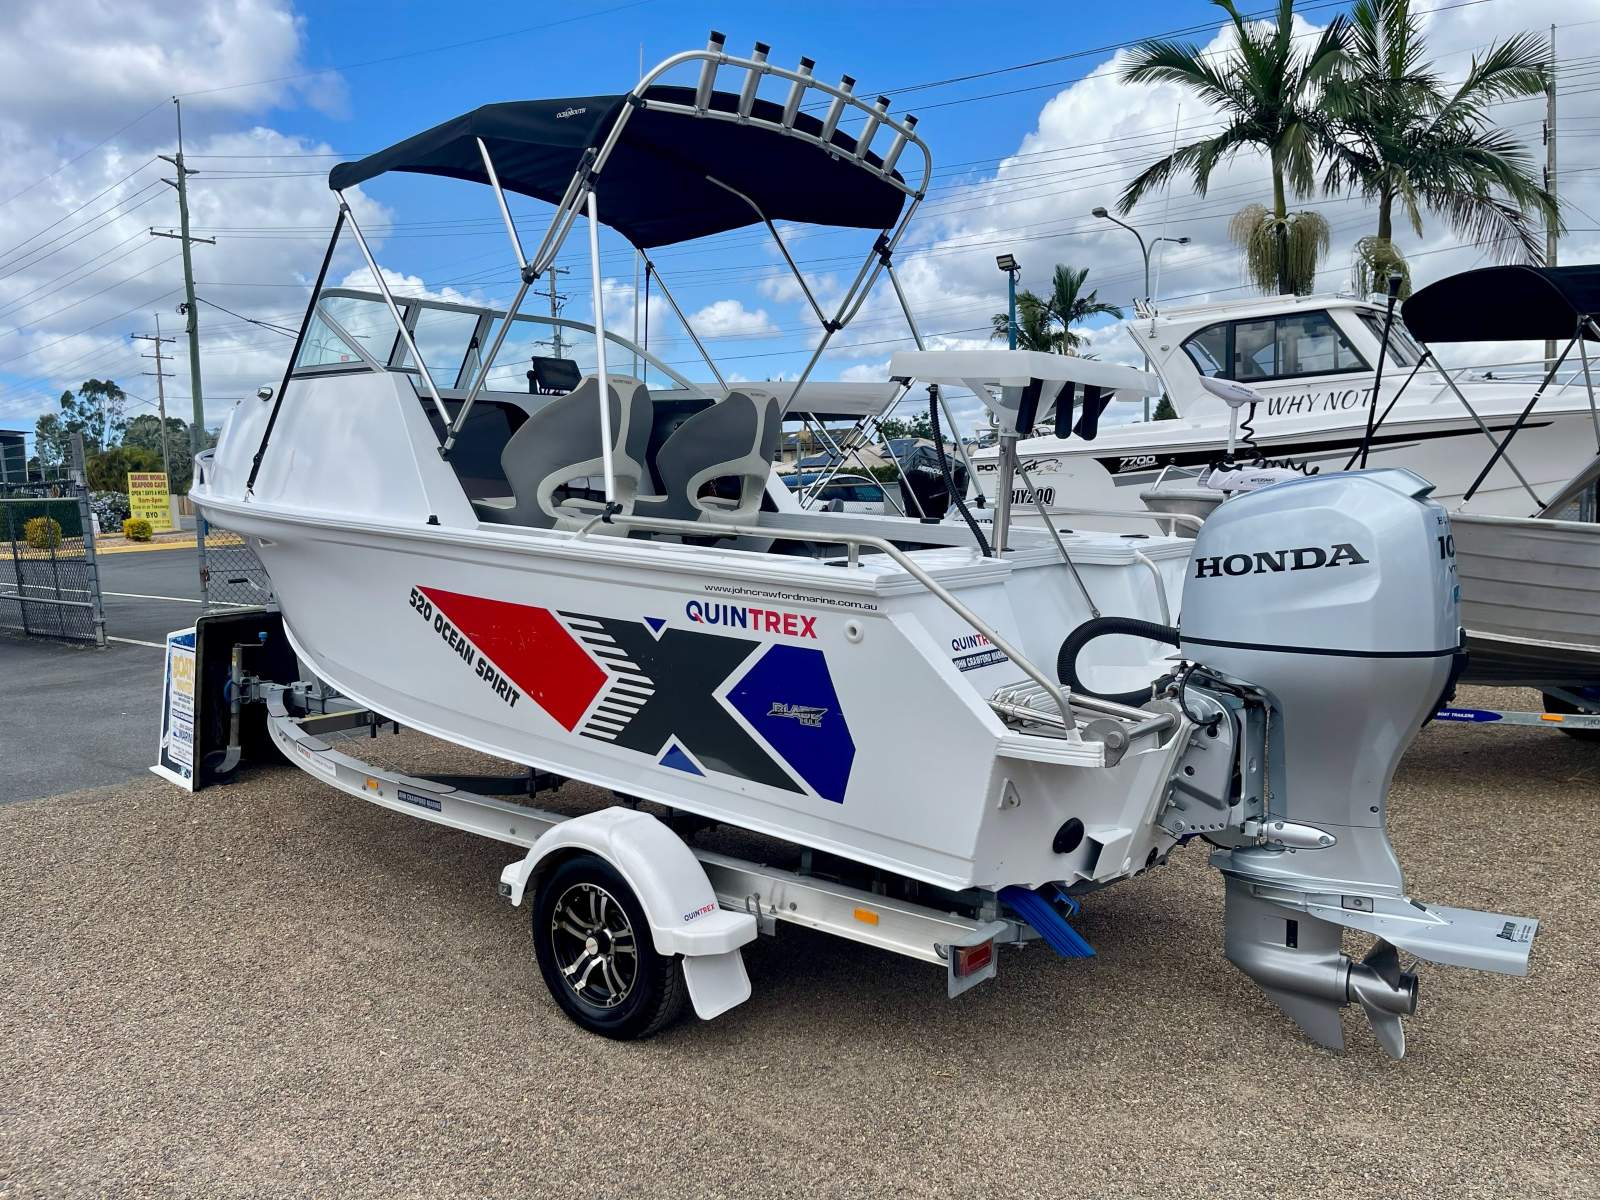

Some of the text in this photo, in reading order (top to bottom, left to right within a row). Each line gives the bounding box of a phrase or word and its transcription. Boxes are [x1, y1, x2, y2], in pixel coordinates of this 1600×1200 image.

[1268, 393, 1321, 416] WHY
[1323, 388, 1376, 411] NOT
[1119, 455, 1156, 467] 7700
[145, 511, 159, 519] BYO
[1194, 543, 1370, 579] HONDA
[704, 584, 878, 611] www.johncrawfordmarine.com.au
[685, 600, 817, 639] QUINTREX
[409, 587, 520, 708] 520 OCEAN SPIRIT
[951, 634, 992, 651] QUINTR
[684, 903, 716, 922] QUINTREX
